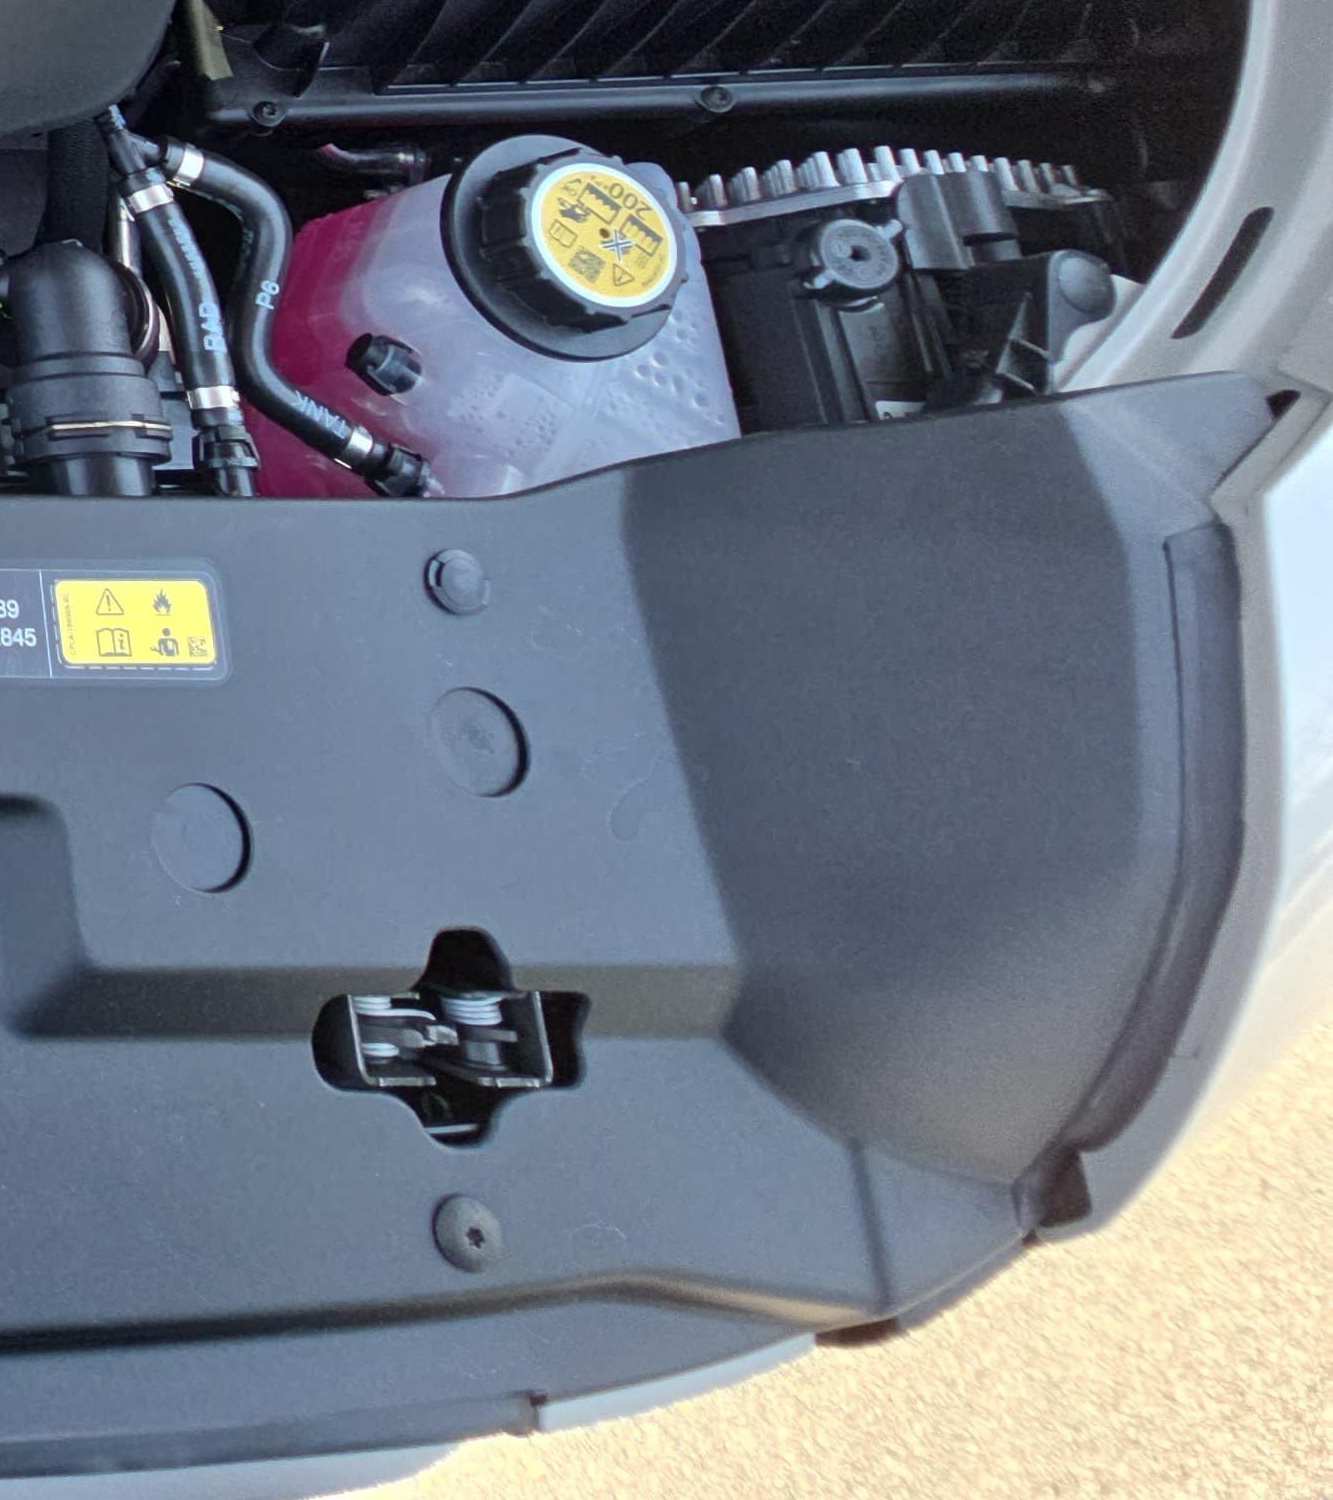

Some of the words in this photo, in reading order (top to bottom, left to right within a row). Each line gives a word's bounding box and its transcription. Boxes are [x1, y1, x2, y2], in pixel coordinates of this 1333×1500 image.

[609, 183, 653, 221] 200
[255, 280, 281, 310] P6
[292, 390, 346, 440] TANK
